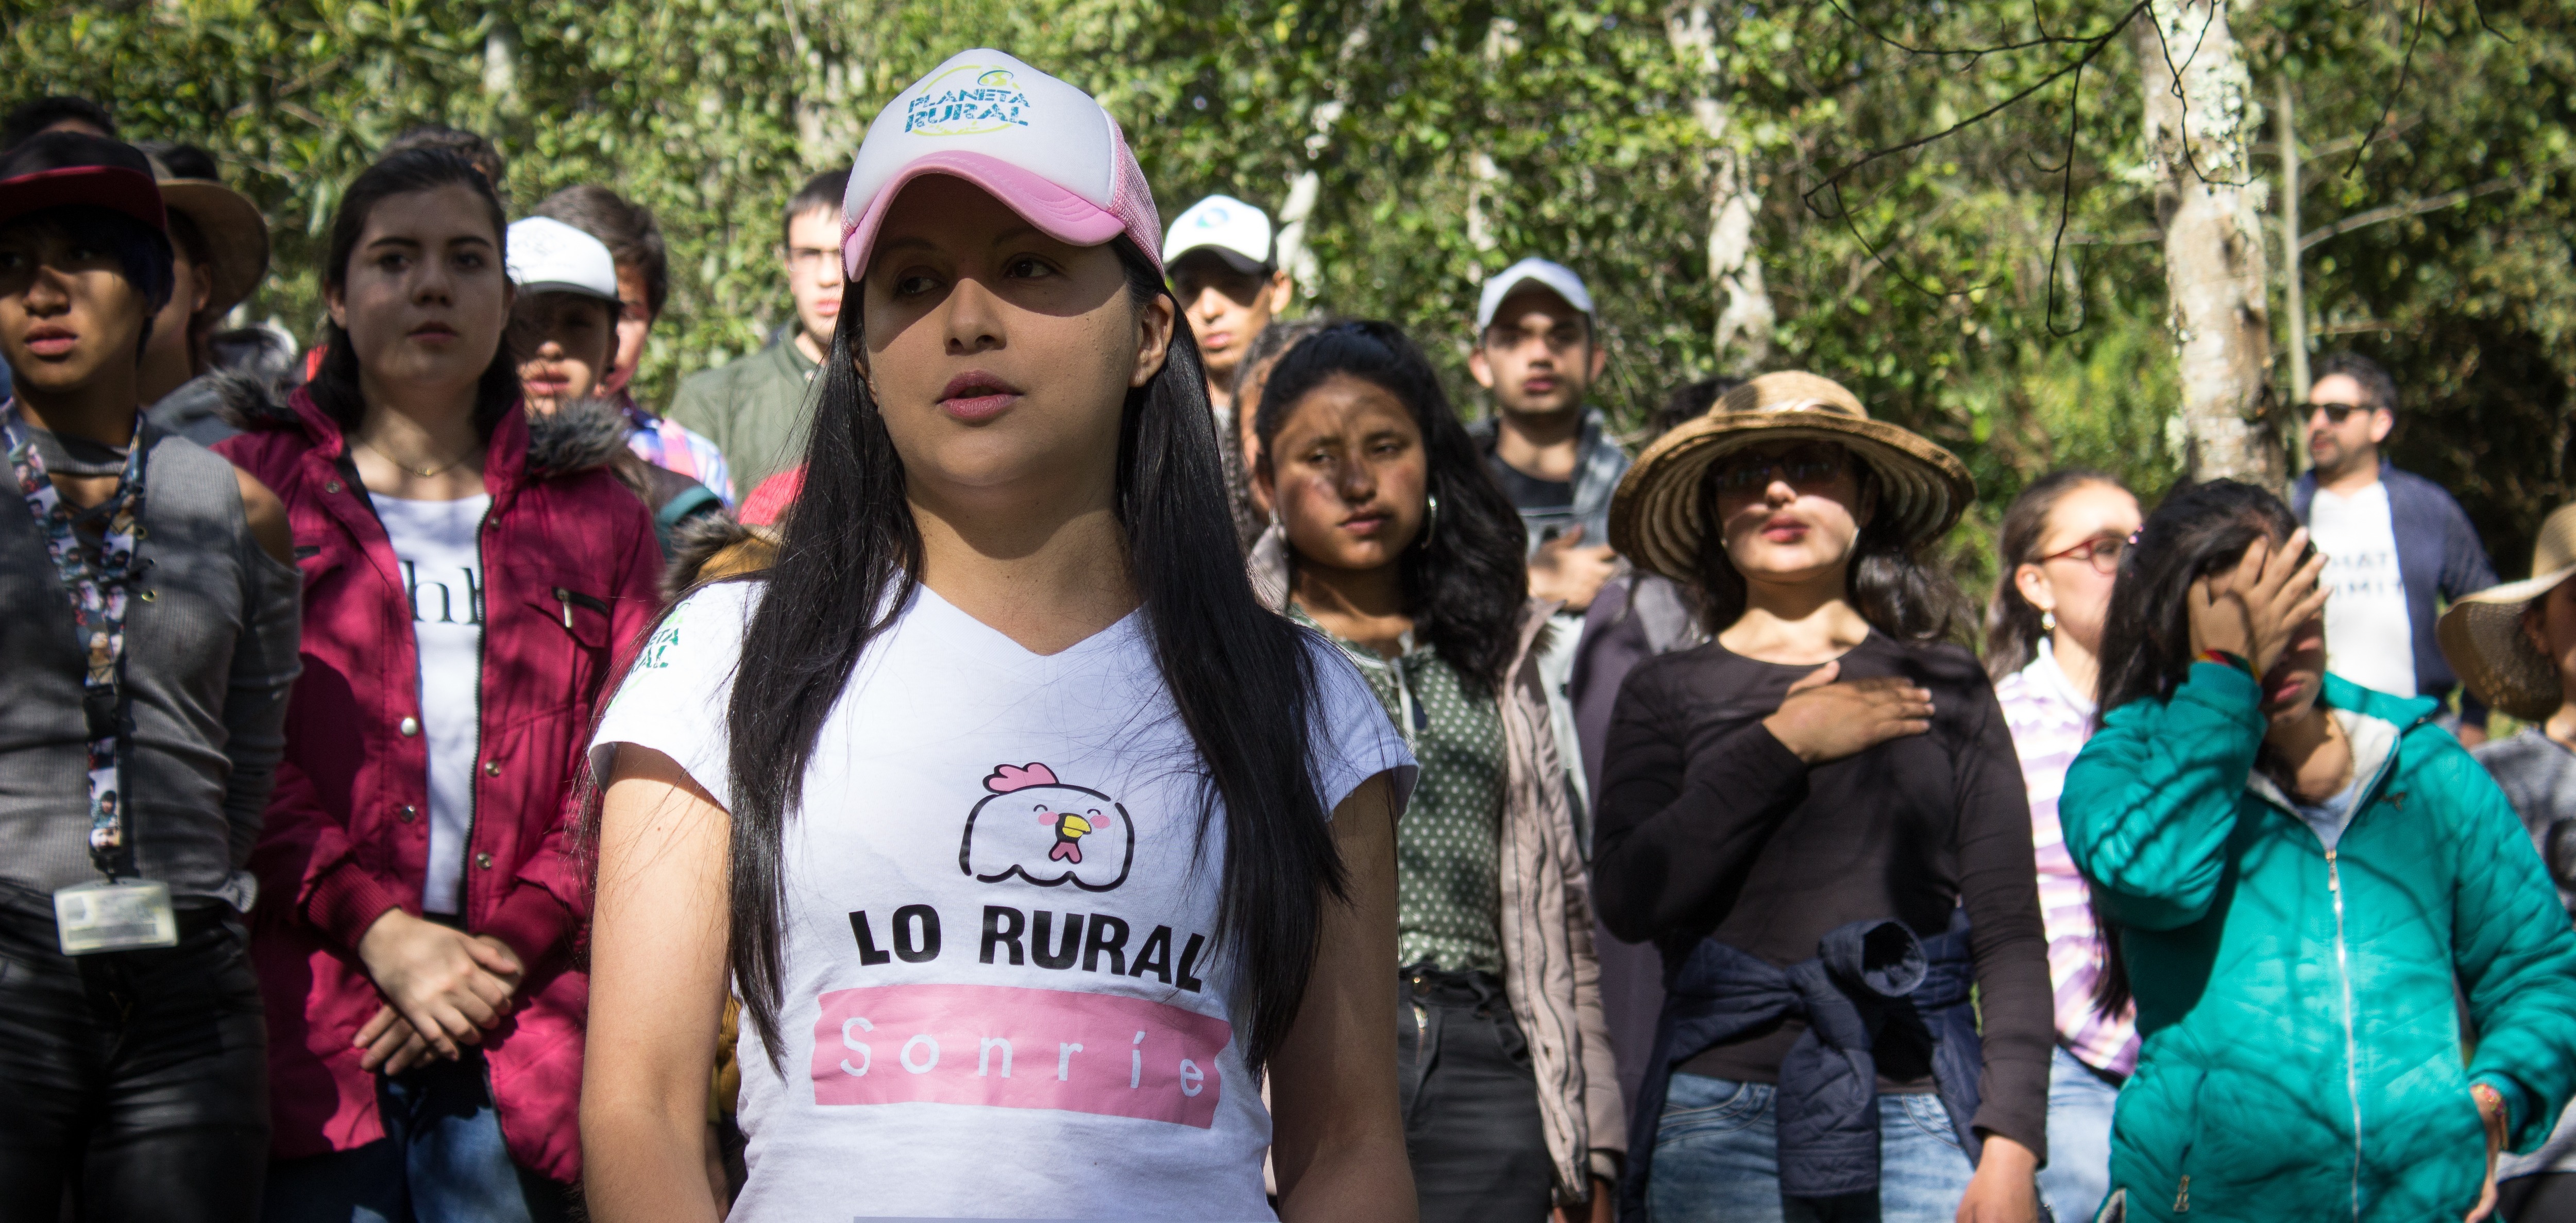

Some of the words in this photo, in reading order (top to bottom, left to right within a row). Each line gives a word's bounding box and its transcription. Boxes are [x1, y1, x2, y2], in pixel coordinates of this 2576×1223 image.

[908, 88, 1030, 113] PLANETA
[904, 104, 1029, 133] RURAL
[631, 645, 669, 674] AL
[849, 904, 941, 966] LO
[979, 905, 1206, 993] RURAL
[840, 1016, 1205, 1097] Sonríe
